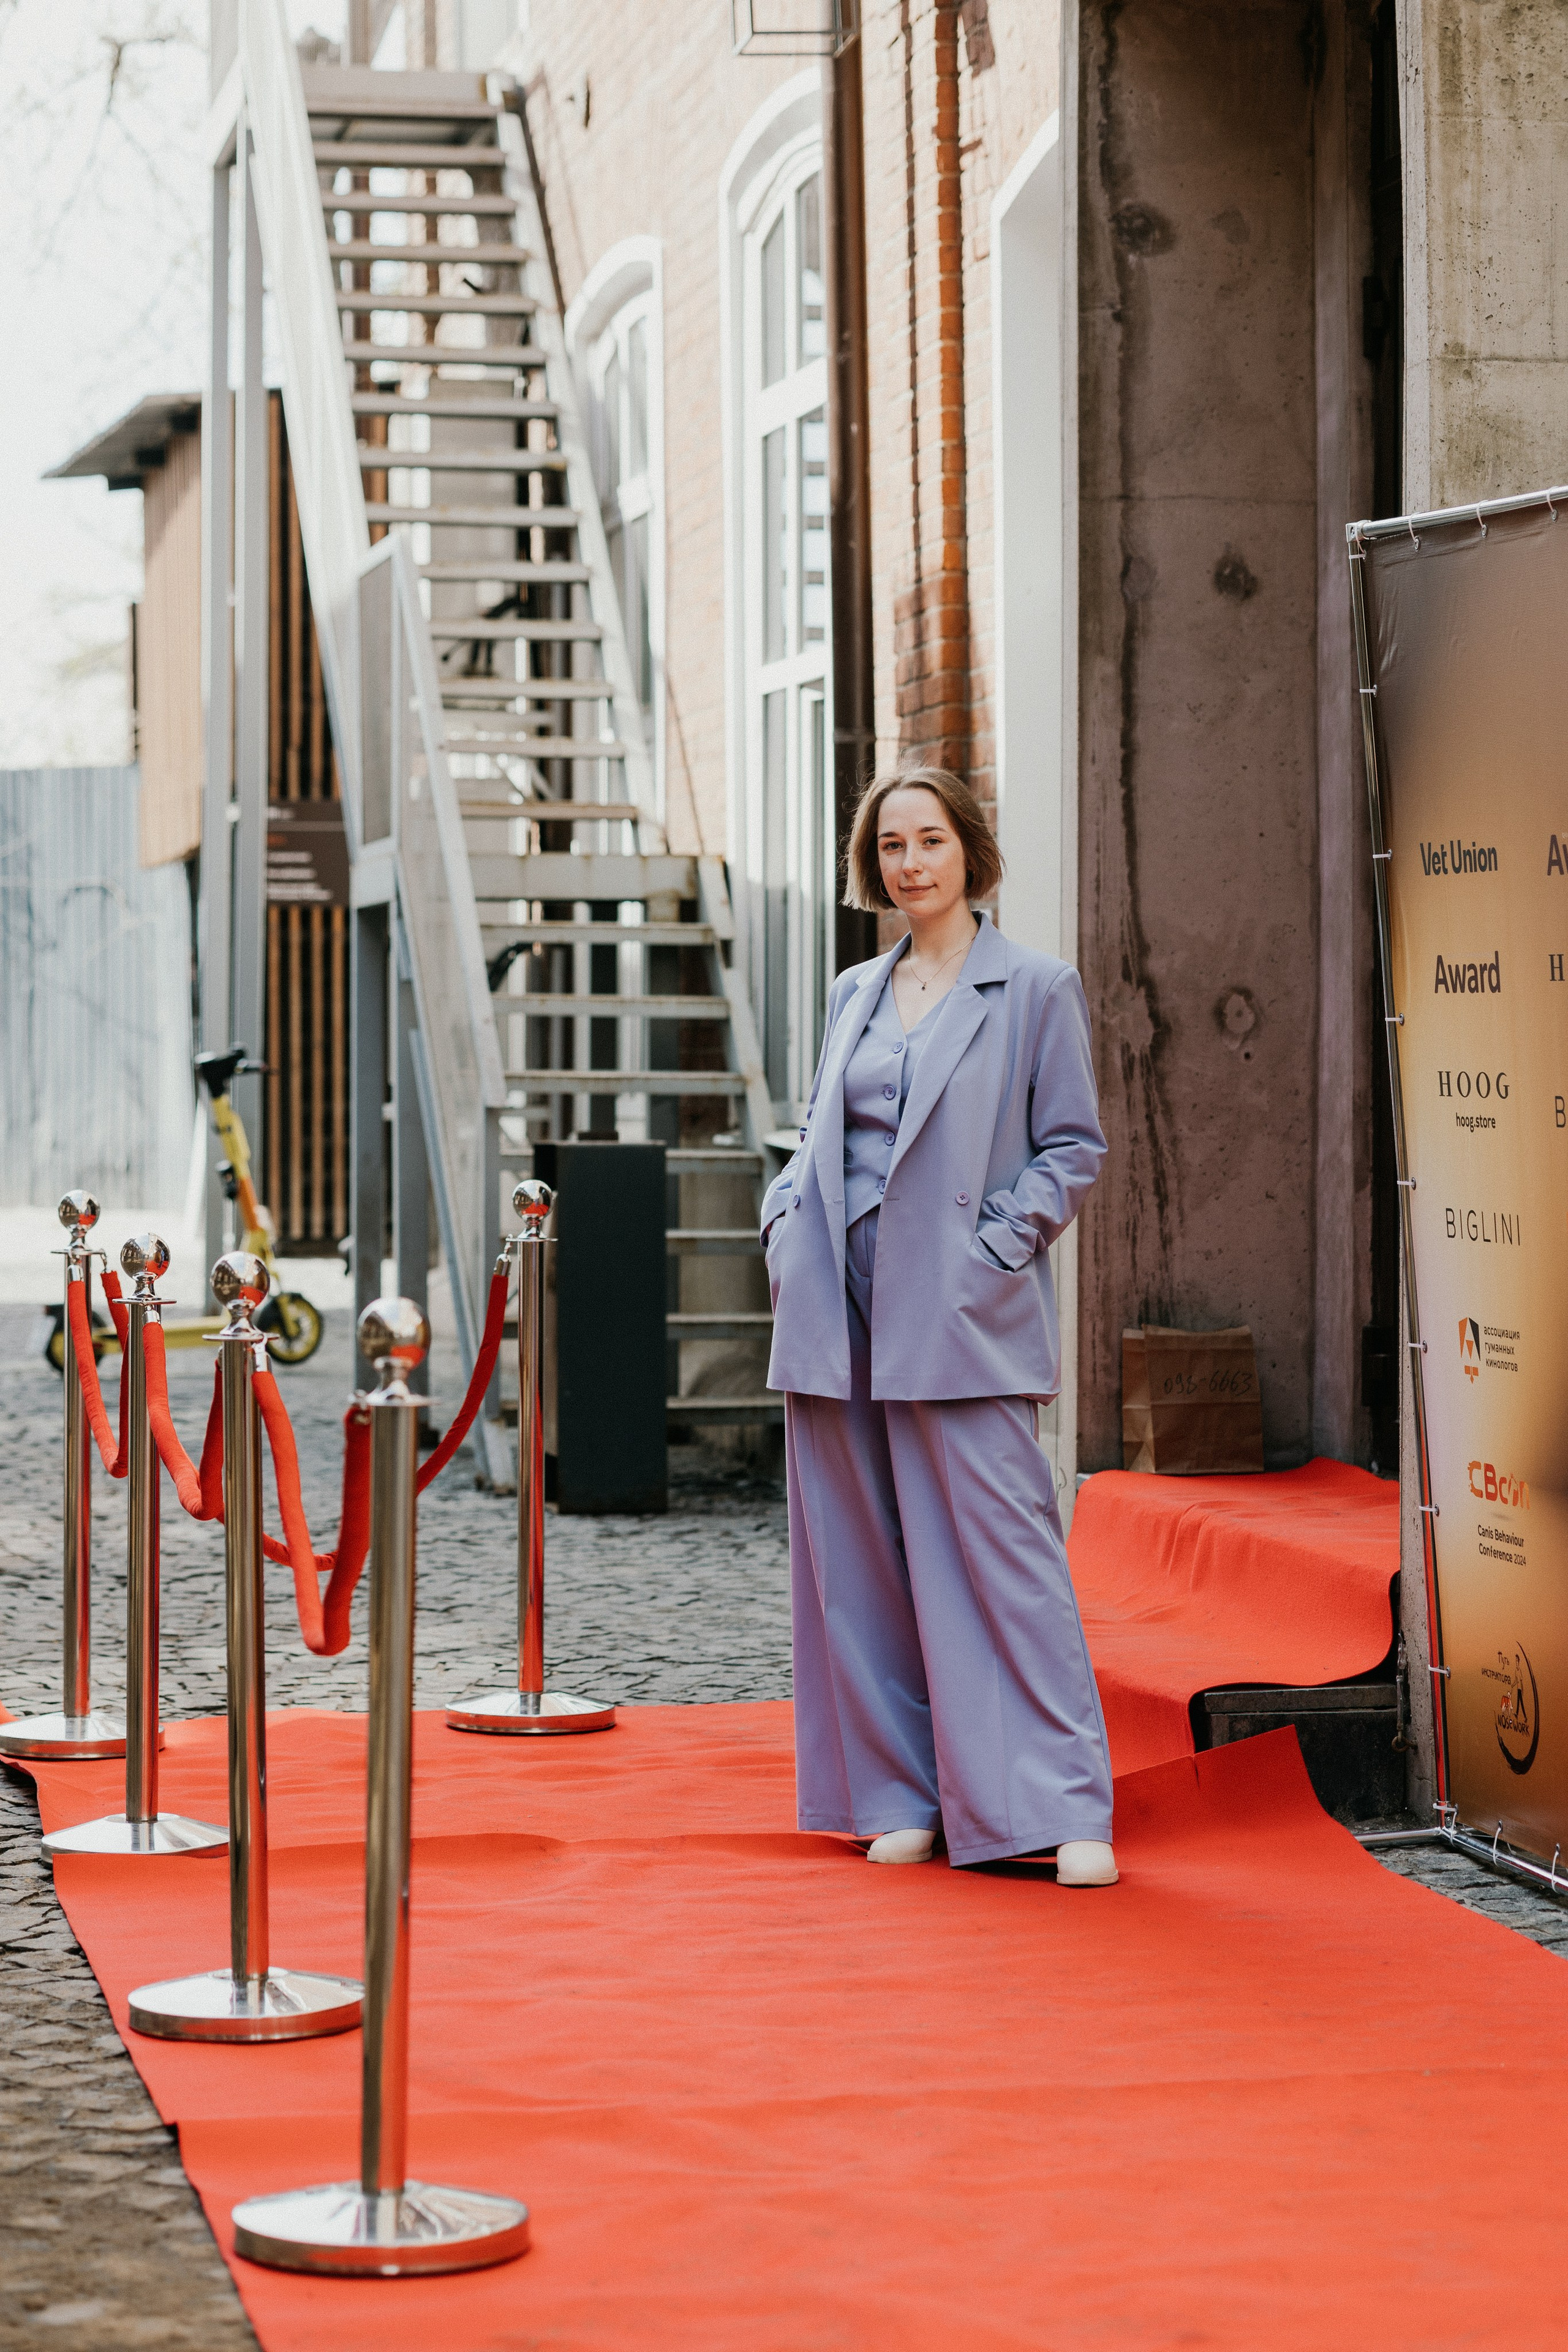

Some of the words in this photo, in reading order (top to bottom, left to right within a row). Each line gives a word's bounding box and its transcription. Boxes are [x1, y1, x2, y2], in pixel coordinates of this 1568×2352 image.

[1420, 842, 1448, 876] Vet
[1450, 840, 1498, 874] Union
[1434, 951, 1501, 993] Award
[1438, 1071, 1510, 1099] HOOG
[1455, 1112, 1496, 1133] hoog.store
[1446, 1207, 1520, 1246] BIGLINI
[1483, 1326, 1520, 1340] ассоциация
[1485, 1342, 1515, 1355] гуманных
[1486, 1358, 1518, 1372] кинологов
[1477, 1524, 1494, 1539] Canis
[1494, 1529, 1524, 1547] Behaviour
[1479, 1542, 1513, 1562] Conference
[1513, 1553, 1526, 1566] 2024
